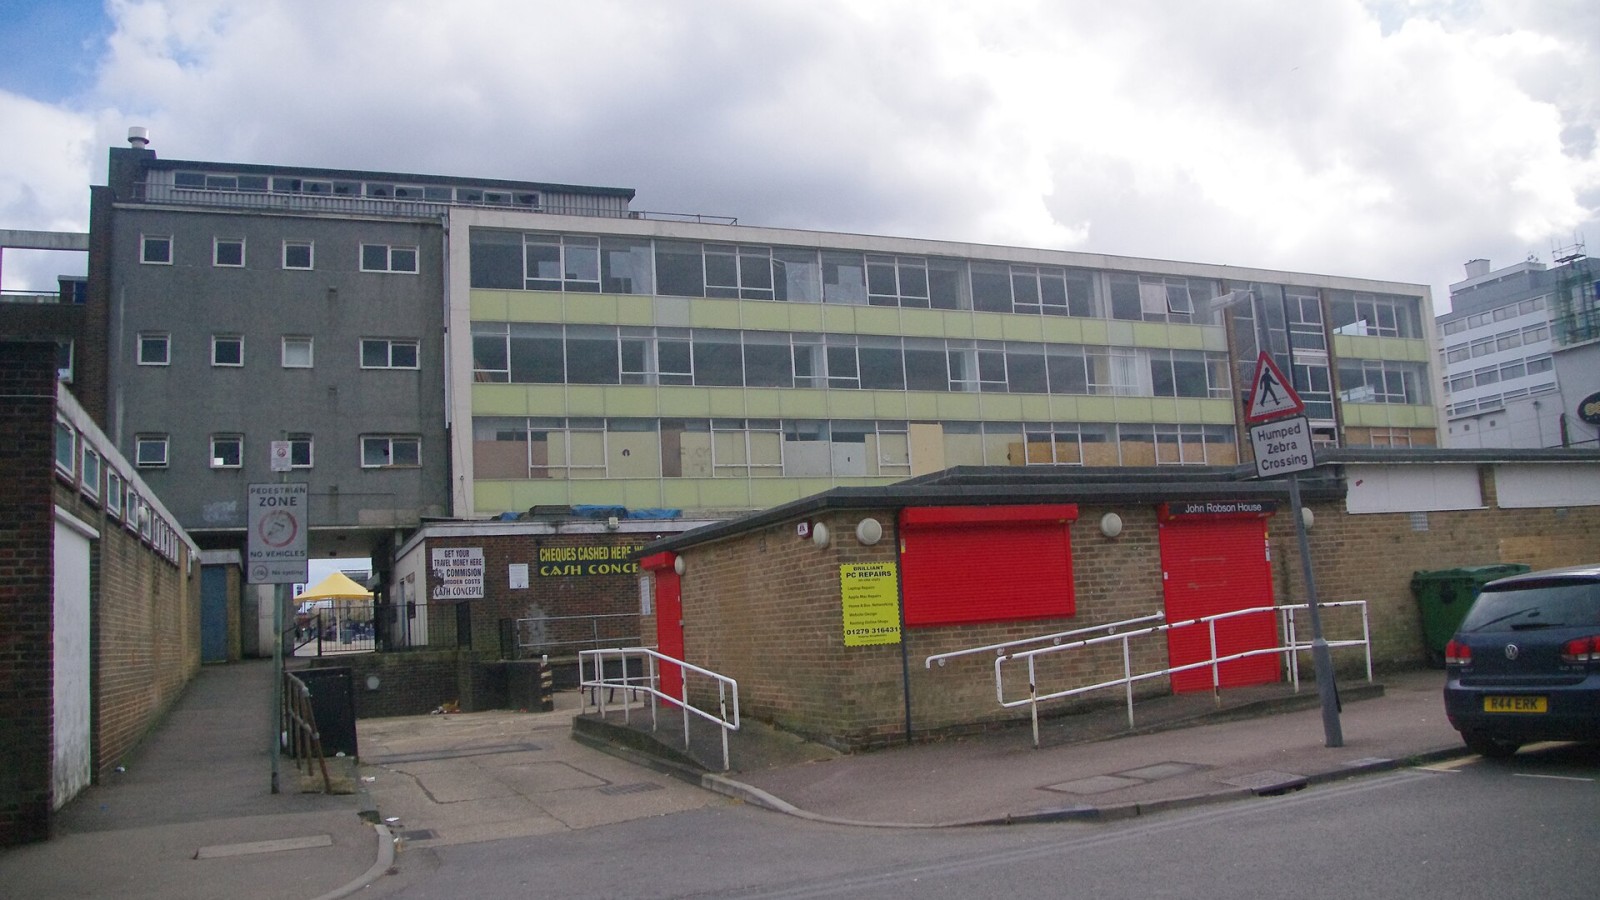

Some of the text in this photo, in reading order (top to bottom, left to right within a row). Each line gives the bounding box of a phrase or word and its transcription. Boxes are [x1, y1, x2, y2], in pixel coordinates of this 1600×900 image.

[1257, 422, 1301, 442] Humped
[1266, 441, 1298, 455] Zebra
[1261, 454, 1308, 471] Crossing
[259, 496, 298, 507] ZONE
[1185, 502, 1262, 513] John Robson House
[265, 550, 305, 558] VEHICLES
[444, 549, 470, 558] GET YOUR
[540, 547, 577, 562] CHEQUES
[577, 546, 609, 561] CASHED
[434, 559, 451, 567] TRAVEL
[452, 559, 469, 567] MONEY
[446, 568, 482, 578] COMMISION
[540, 564, 581, 576] CASH
[871, 626, 898, 634] 316431
[1491, 698, 1538, 710] R44 ERK
